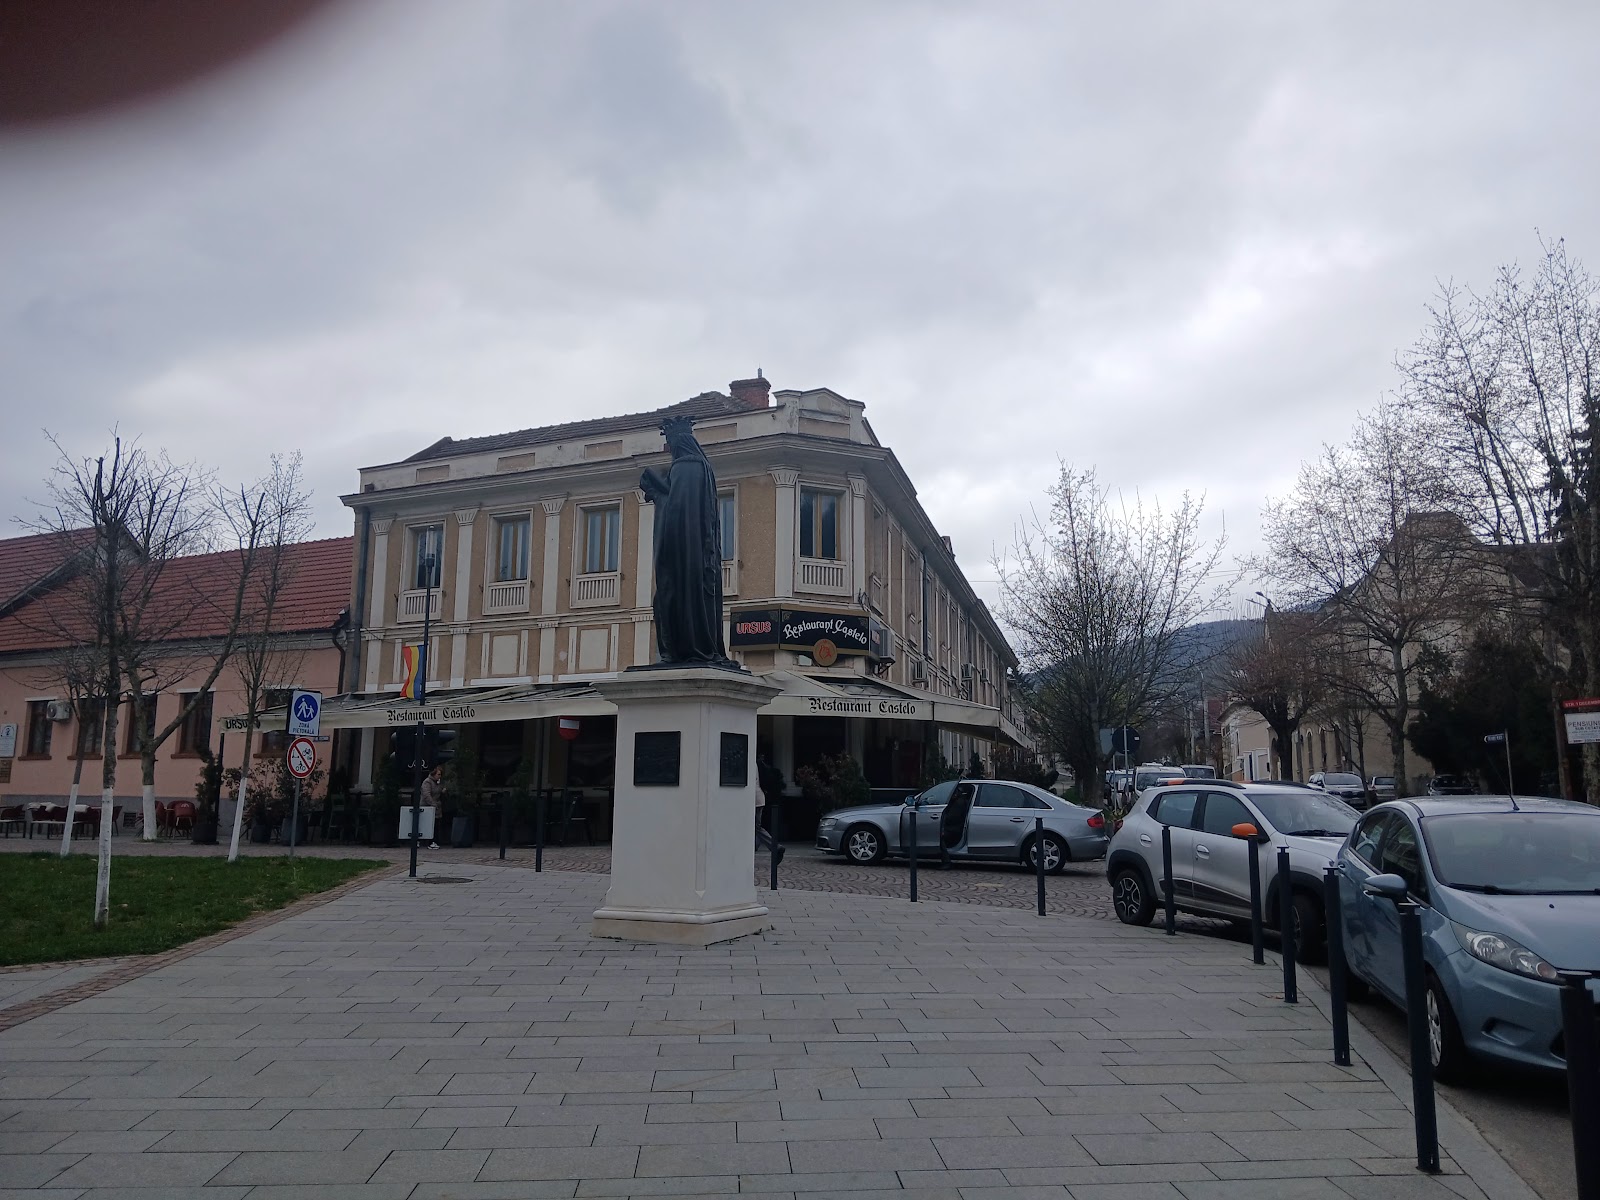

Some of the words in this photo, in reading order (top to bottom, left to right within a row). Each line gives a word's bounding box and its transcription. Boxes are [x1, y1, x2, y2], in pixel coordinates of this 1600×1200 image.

[736, 621, 772, 635] URSUS
[783, 619, 833, 639] Restaurant
[832, 619, 868, 645] Castelo
[386, 708, 437, 724] Restaurant
[443, 706, 475, 721] Castelo
[808, 698, 872, 713] Restaurant
[878, 700, 916, 716] Castelo
[226, 719, 252, 730] URSU
